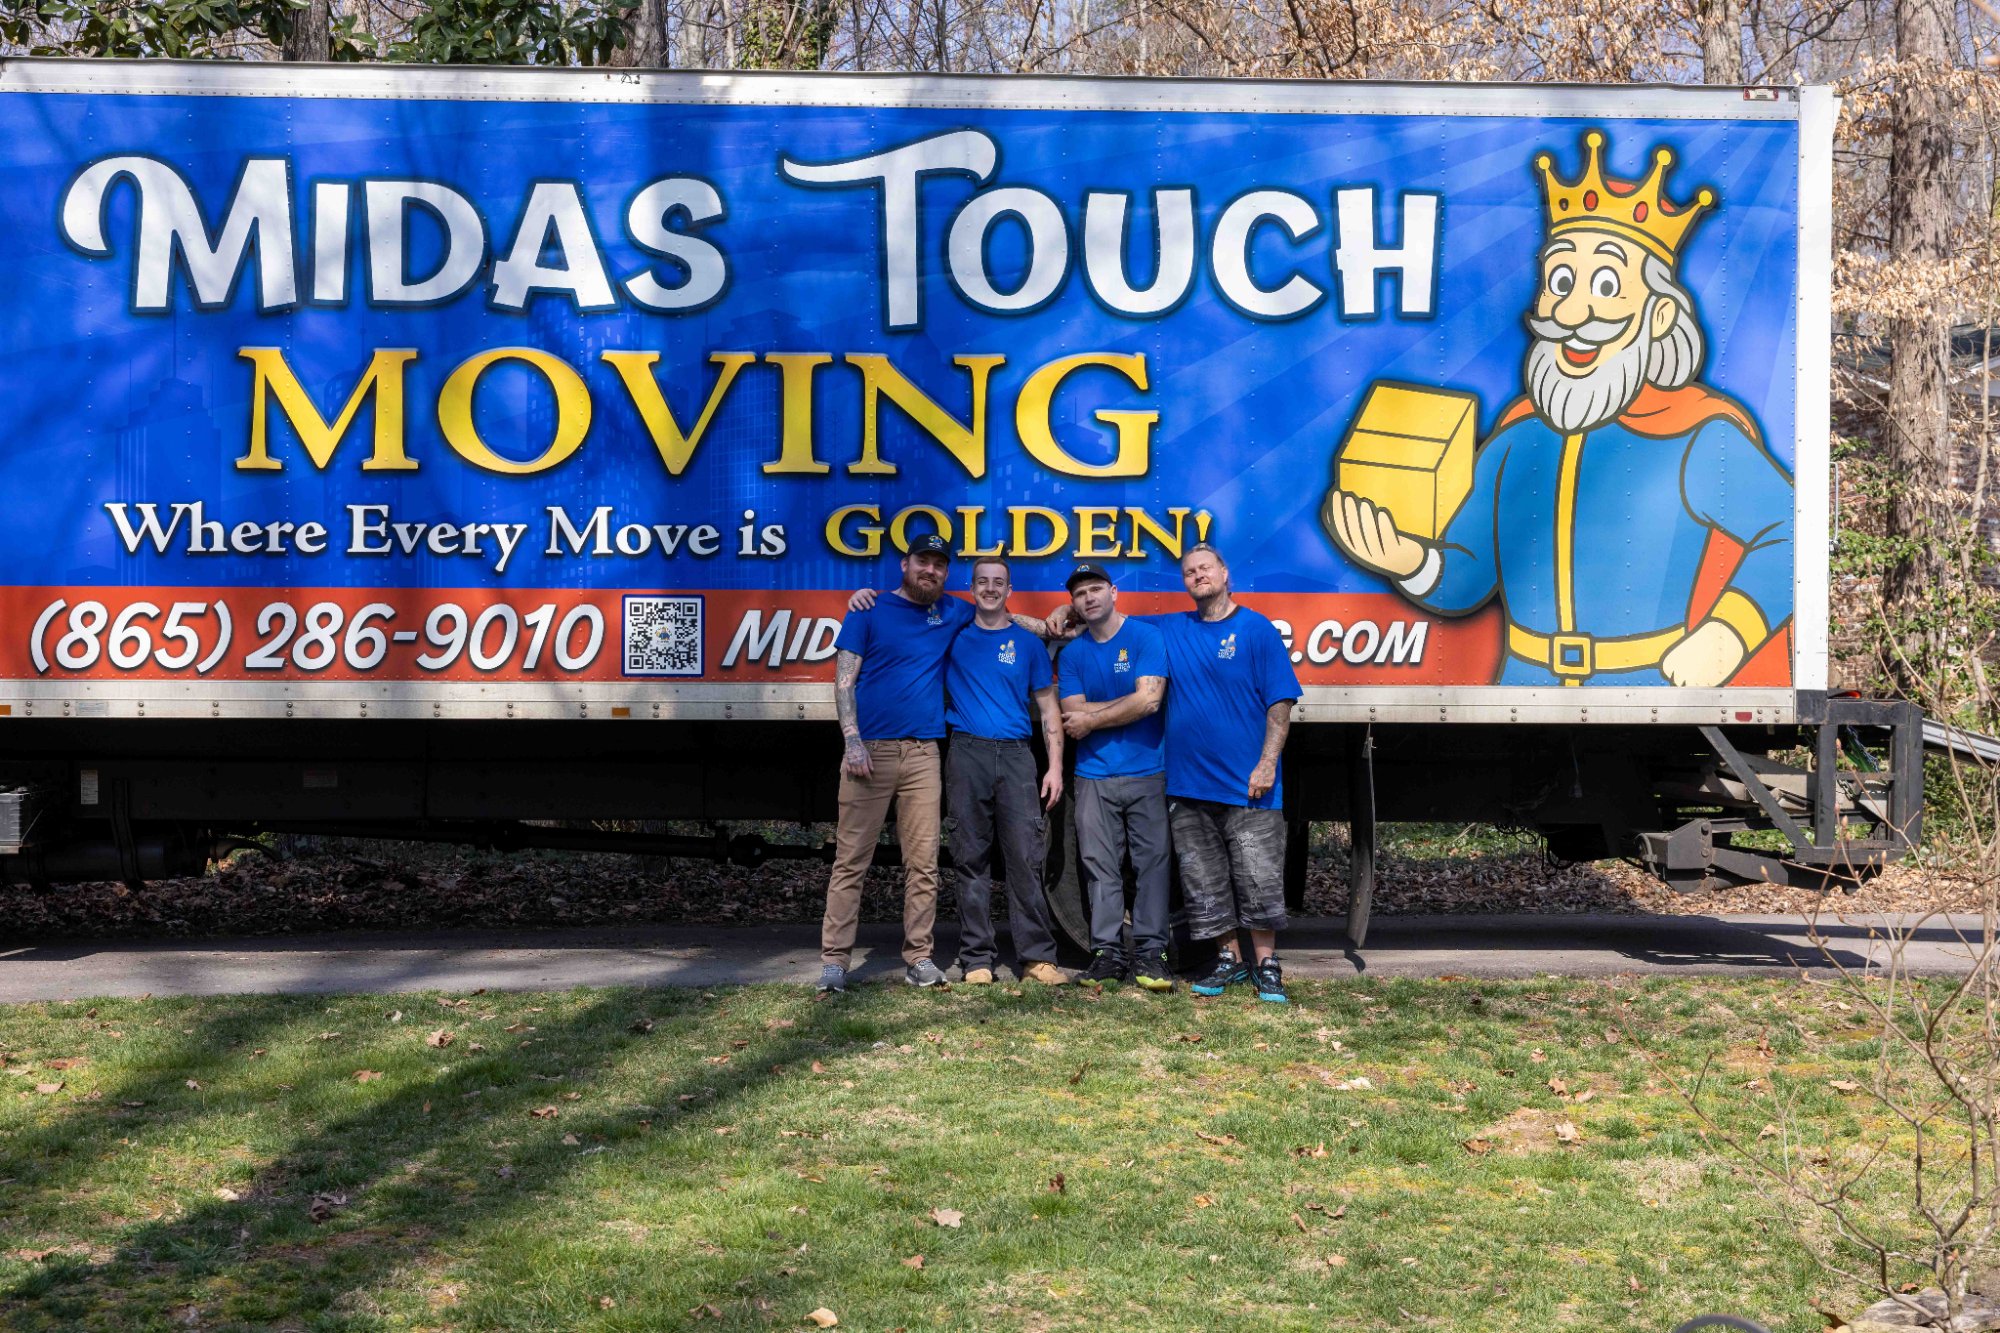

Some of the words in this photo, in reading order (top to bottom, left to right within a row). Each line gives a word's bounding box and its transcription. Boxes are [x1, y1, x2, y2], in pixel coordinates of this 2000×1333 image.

[62, 156, 726, 309] MIDAS
[783, 130, 1438, 327] TOUCH
[235, 345, 1160, 477] MOVING
[104, 501, 327, 554] Where
[346, 504, 528, 573] Every
[545, 506, 720, 556] Move
[738, 509, 786, 557] is
[824, 504, 1213, 559] GOLDEN!
[30, 599, 232, 673] (865)
[245, 602, 605, 670] 286-9010
